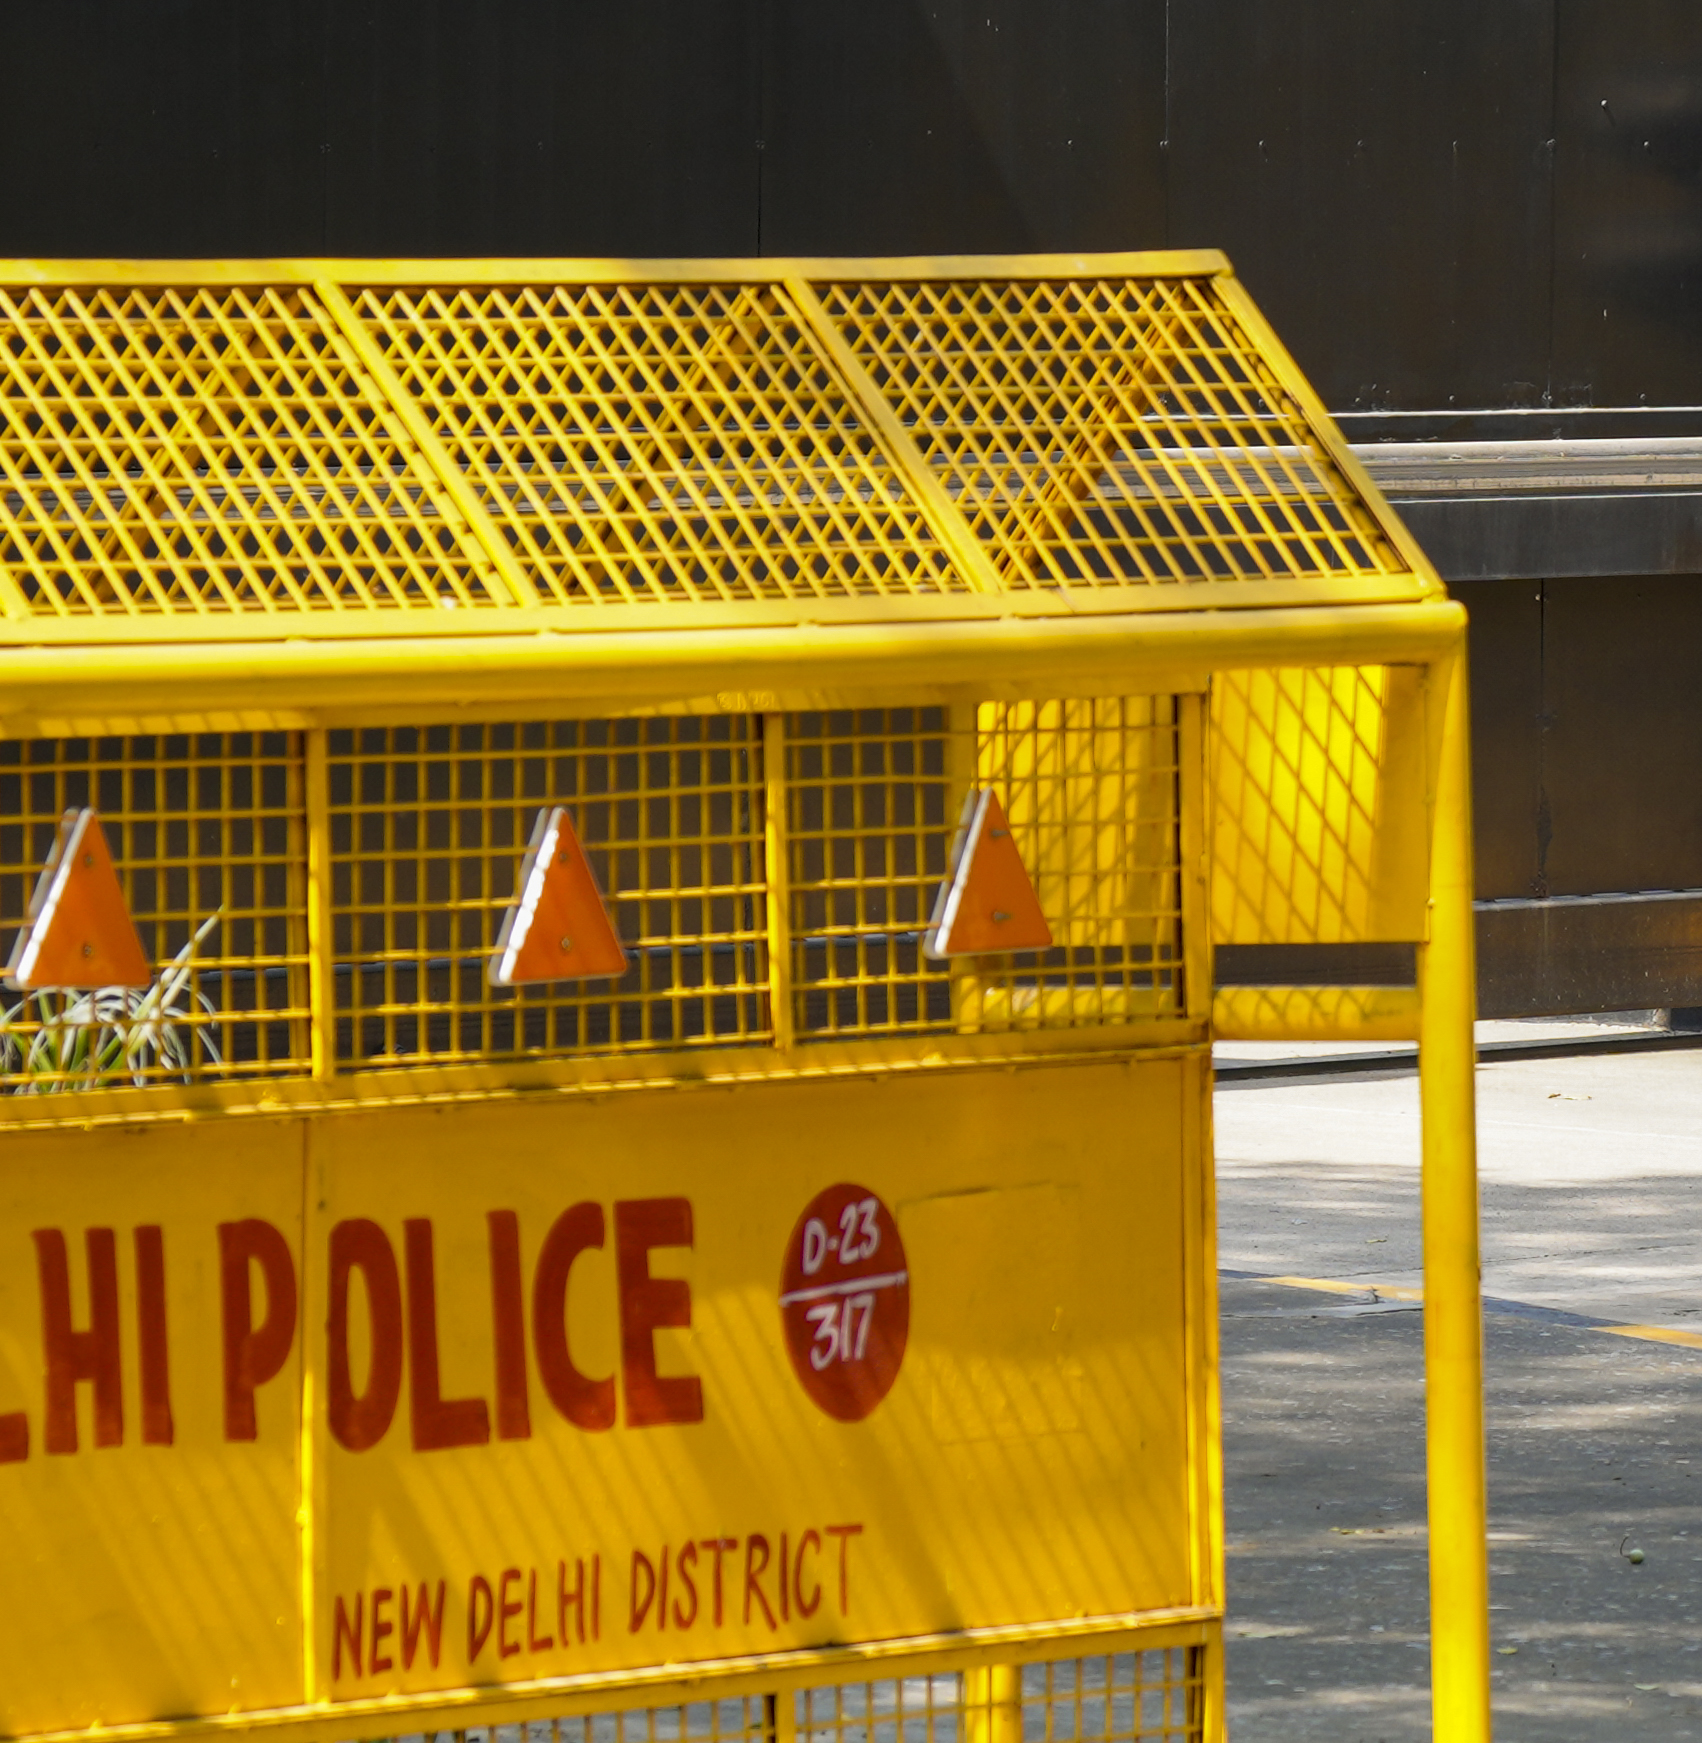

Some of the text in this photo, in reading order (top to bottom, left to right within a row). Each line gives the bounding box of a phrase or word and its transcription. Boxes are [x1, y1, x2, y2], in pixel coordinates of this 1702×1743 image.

[0, 1196, 705, 1464] HI POLICE
[805, 1291, 876, 1372] 317
[332, 1522, 865, 1682] NEW DELHI DISTRICT
